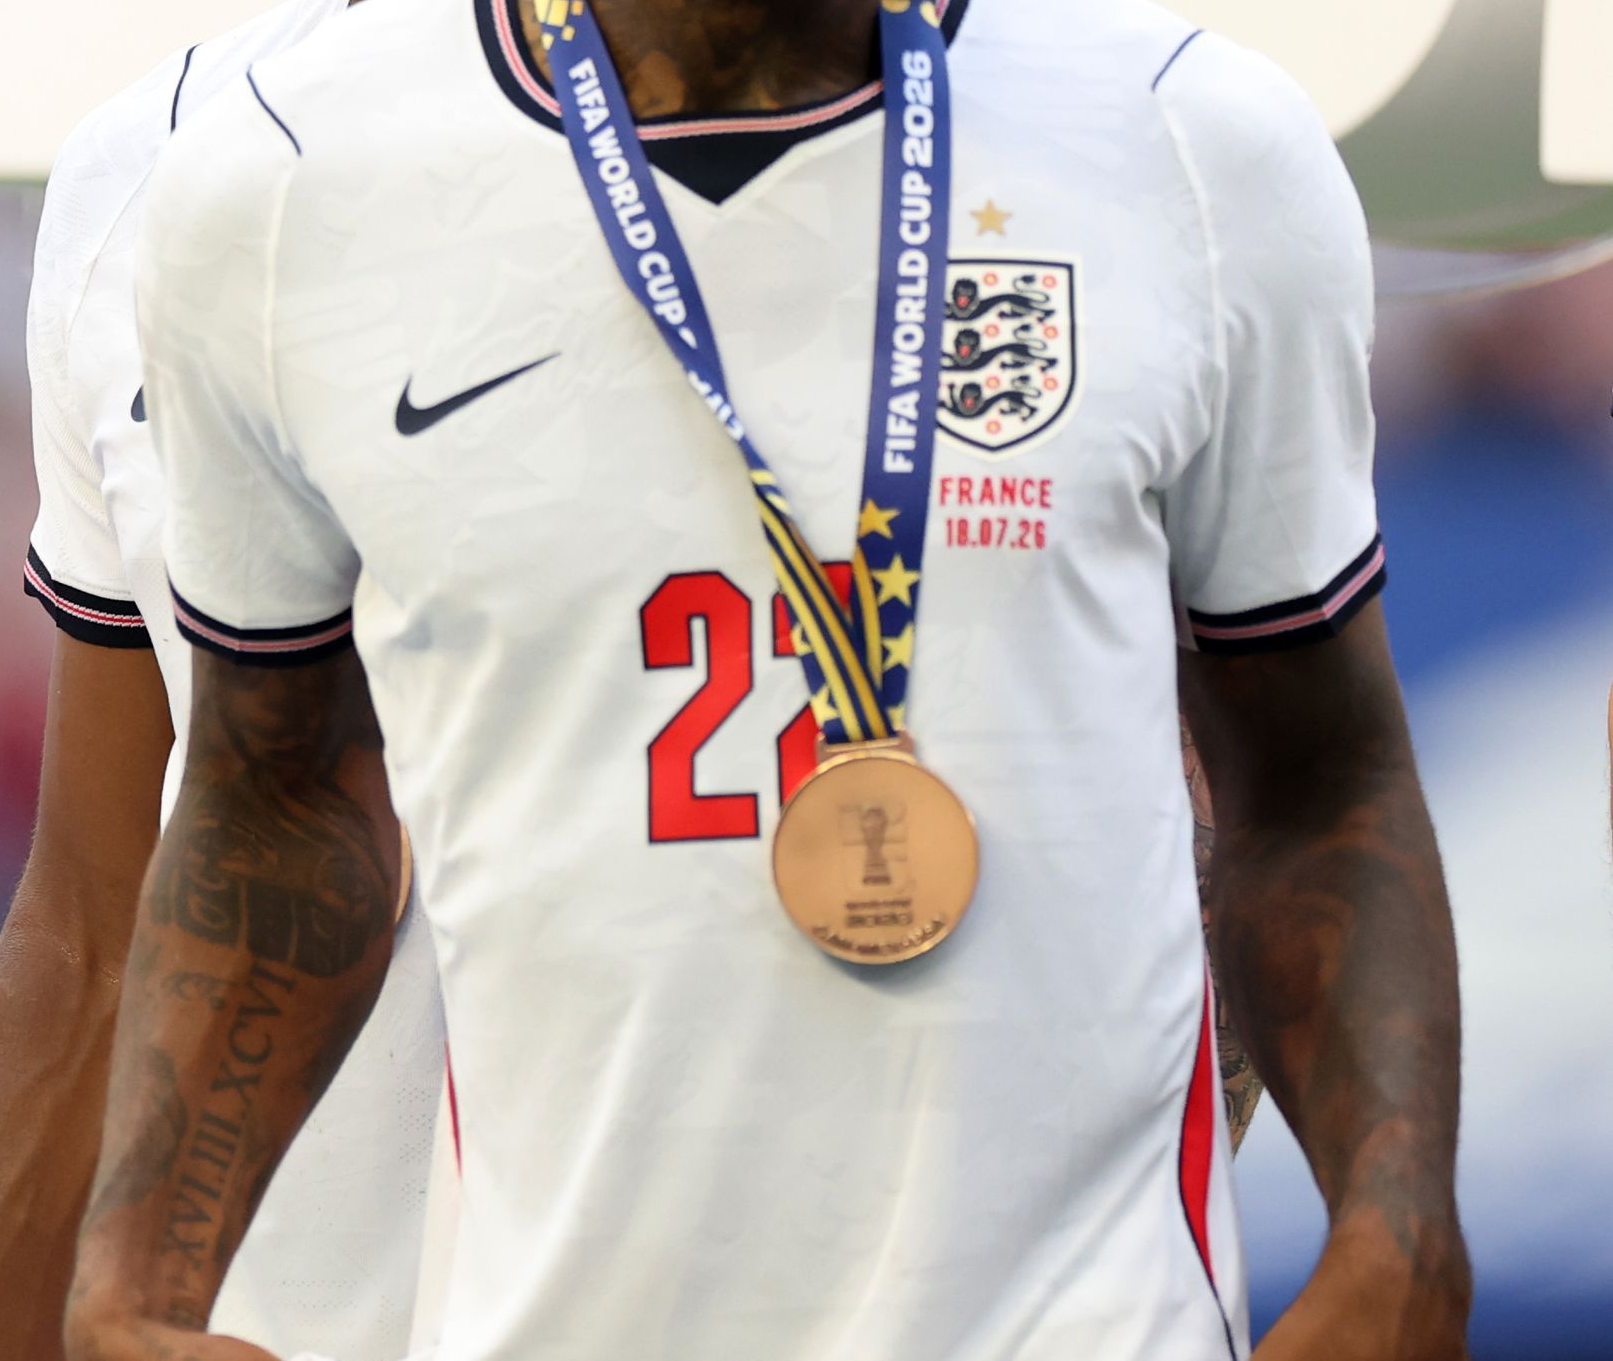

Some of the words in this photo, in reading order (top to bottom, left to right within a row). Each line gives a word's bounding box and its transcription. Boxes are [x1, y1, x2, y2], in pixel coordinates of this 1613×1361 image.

[569, 57, 610, 133] FIFA
[901, 50, 934, 168] 2026
[588, 129, 656, 251] WORLD
[899, 171, 933, 244] CUP
[636, 251, 686, 326] CUP
[890, 246, 929, 389] WORLD
[883, 391, 921, 474] FIFA
[940, 476, 1053, 509] FRANCE
[945, 517, 1046, 550] 18.07.26
